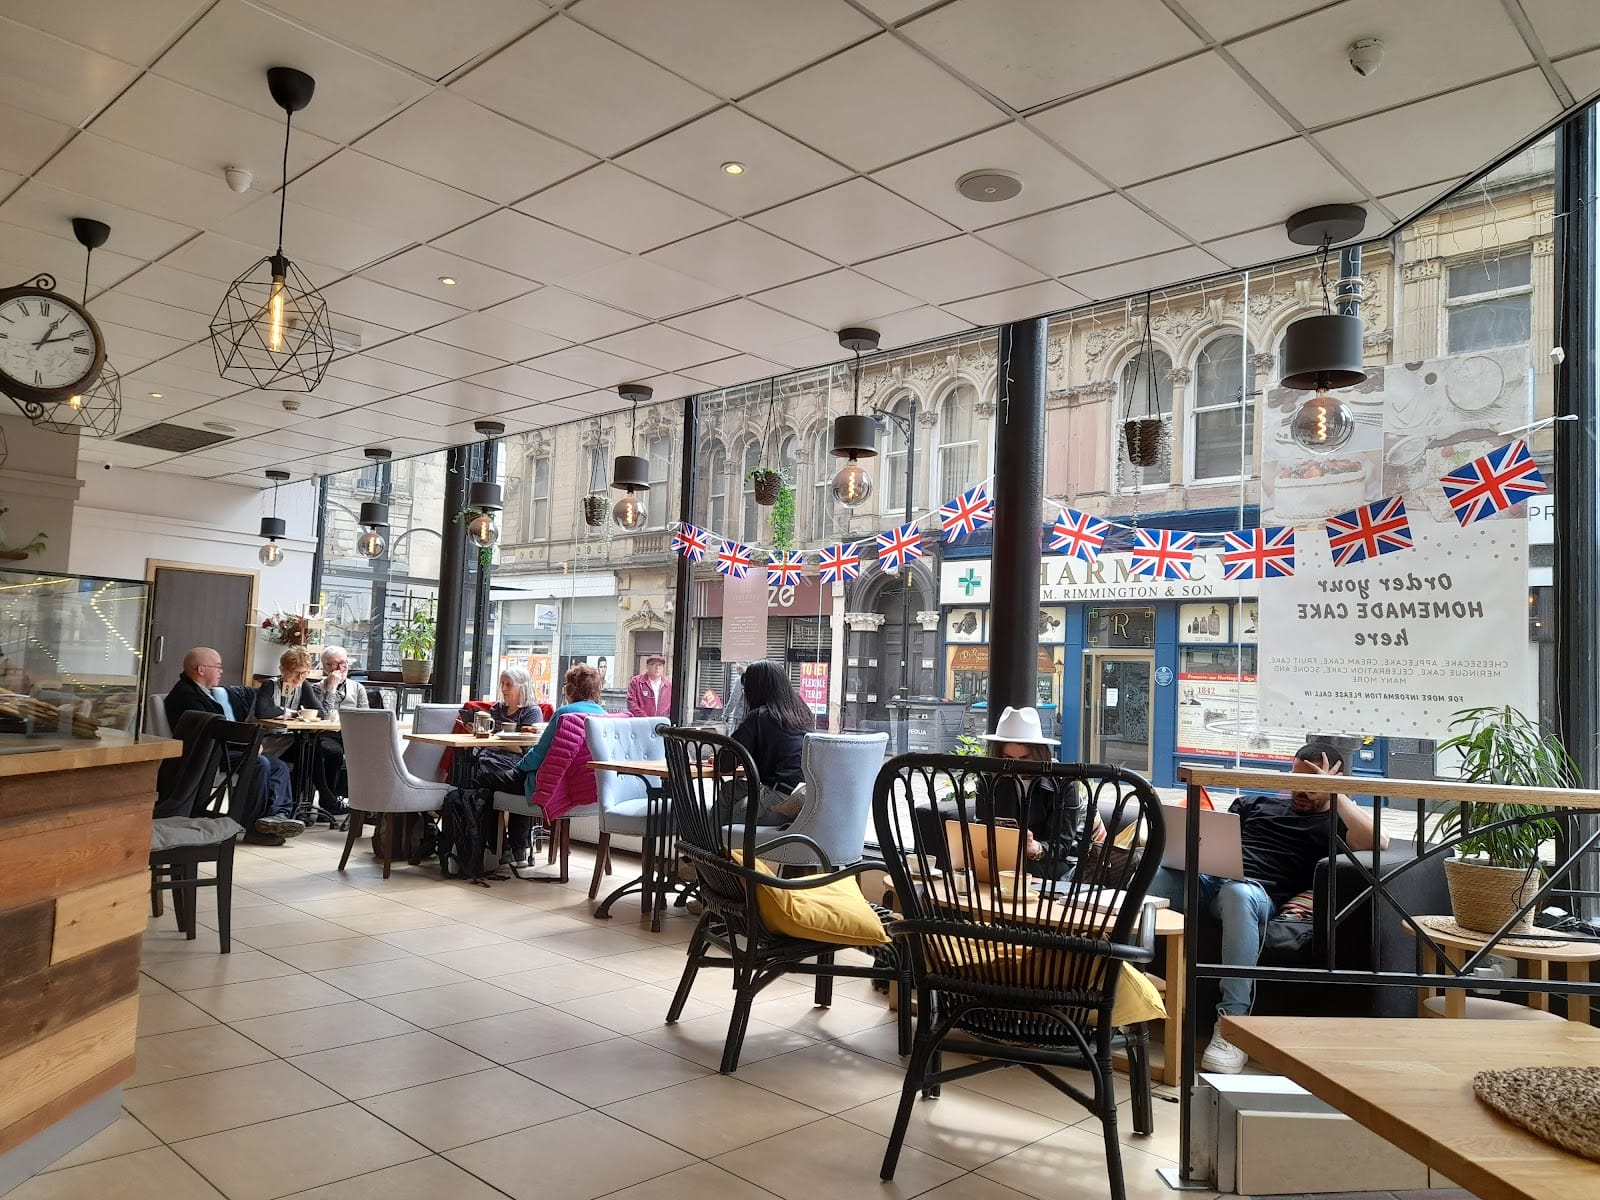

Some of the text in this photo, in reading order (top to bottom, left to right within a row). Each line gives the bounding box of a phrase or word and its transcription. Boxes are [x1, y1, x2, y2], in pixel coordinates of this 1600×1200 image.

[1063, 586, 1159, 599] RIMMINGTON
[1164, 586, 1176, 597] &
[1182, 584, 1214, 597] SON
[1110, 611, 1131, 639] R
[802, 663, 812, 676] TO
[1197, 687, 1216, 695] 1842
